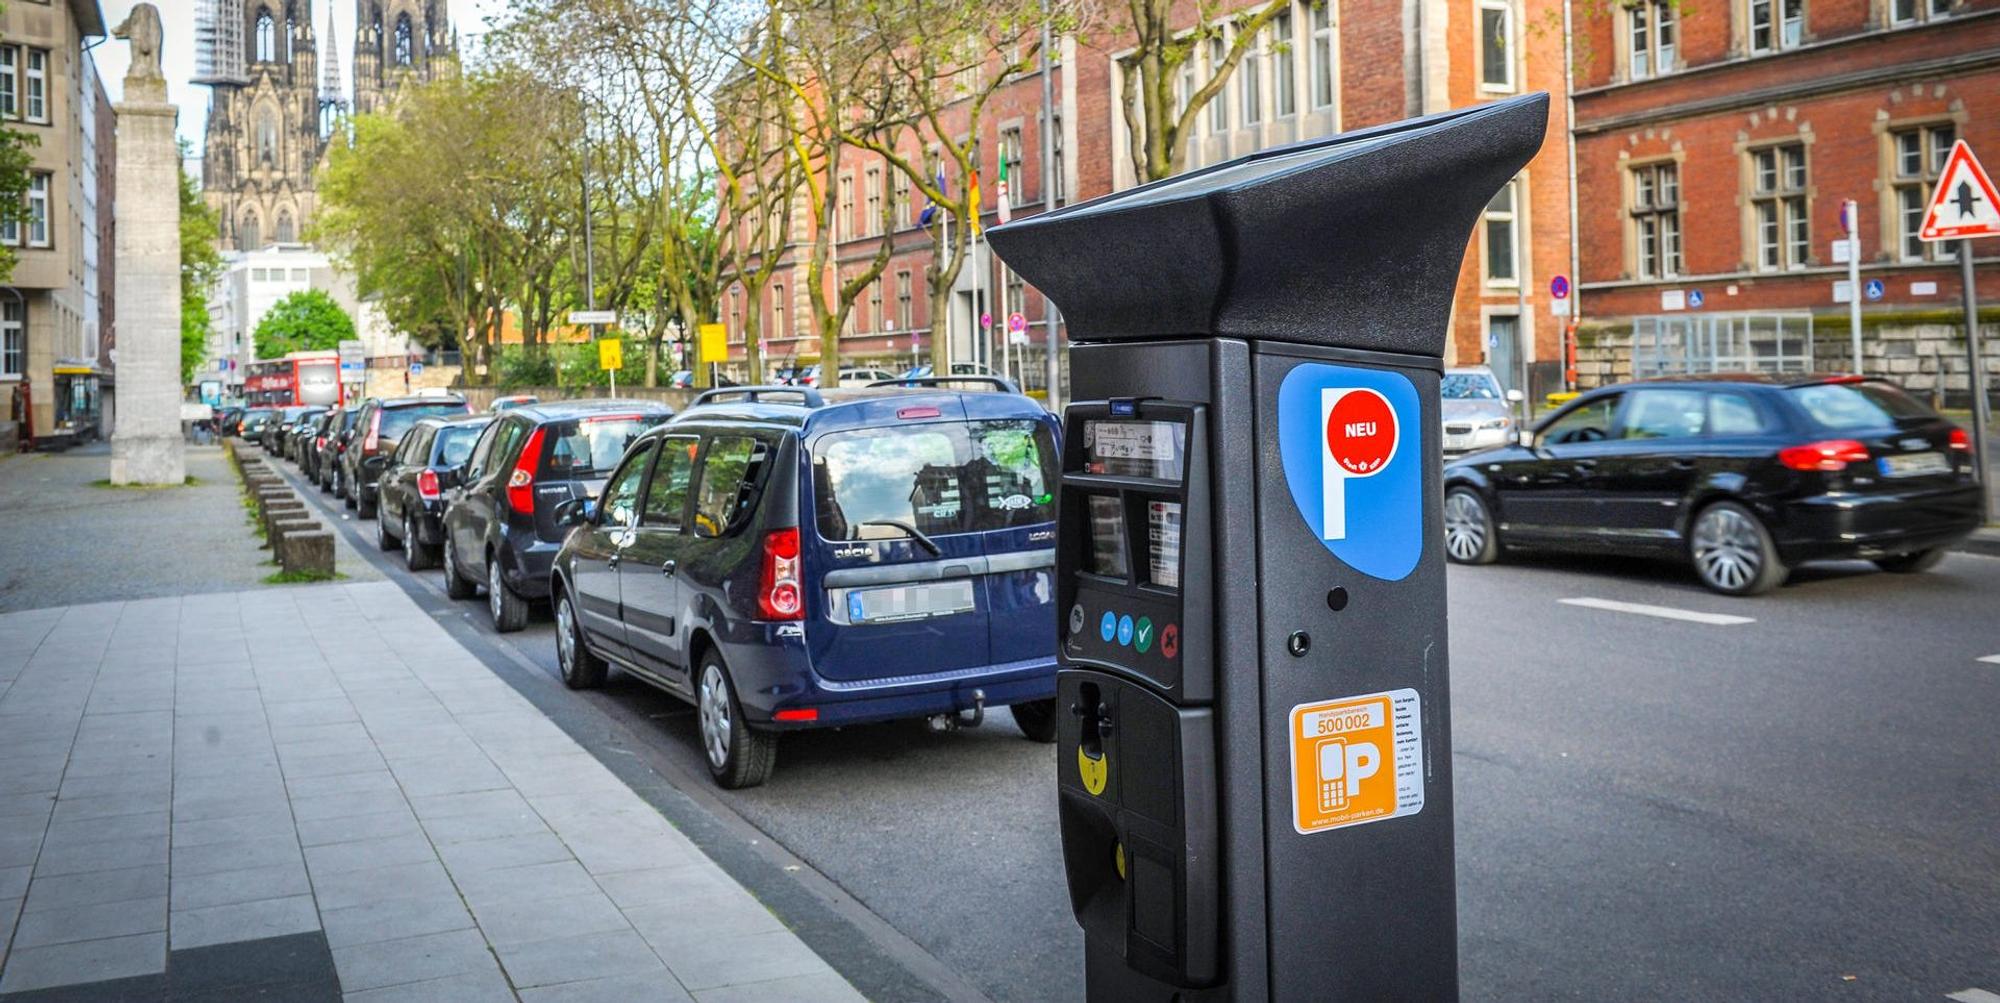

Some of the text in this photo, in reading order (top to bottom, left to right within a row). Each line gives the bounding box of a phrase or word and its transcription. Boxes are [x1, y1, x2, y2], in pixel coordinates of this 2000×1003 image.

[1345, 422, 1377, 437] NEU
[1318, 713, 1370, 734] 500 002
[1345, 742, 1381, 797] P
